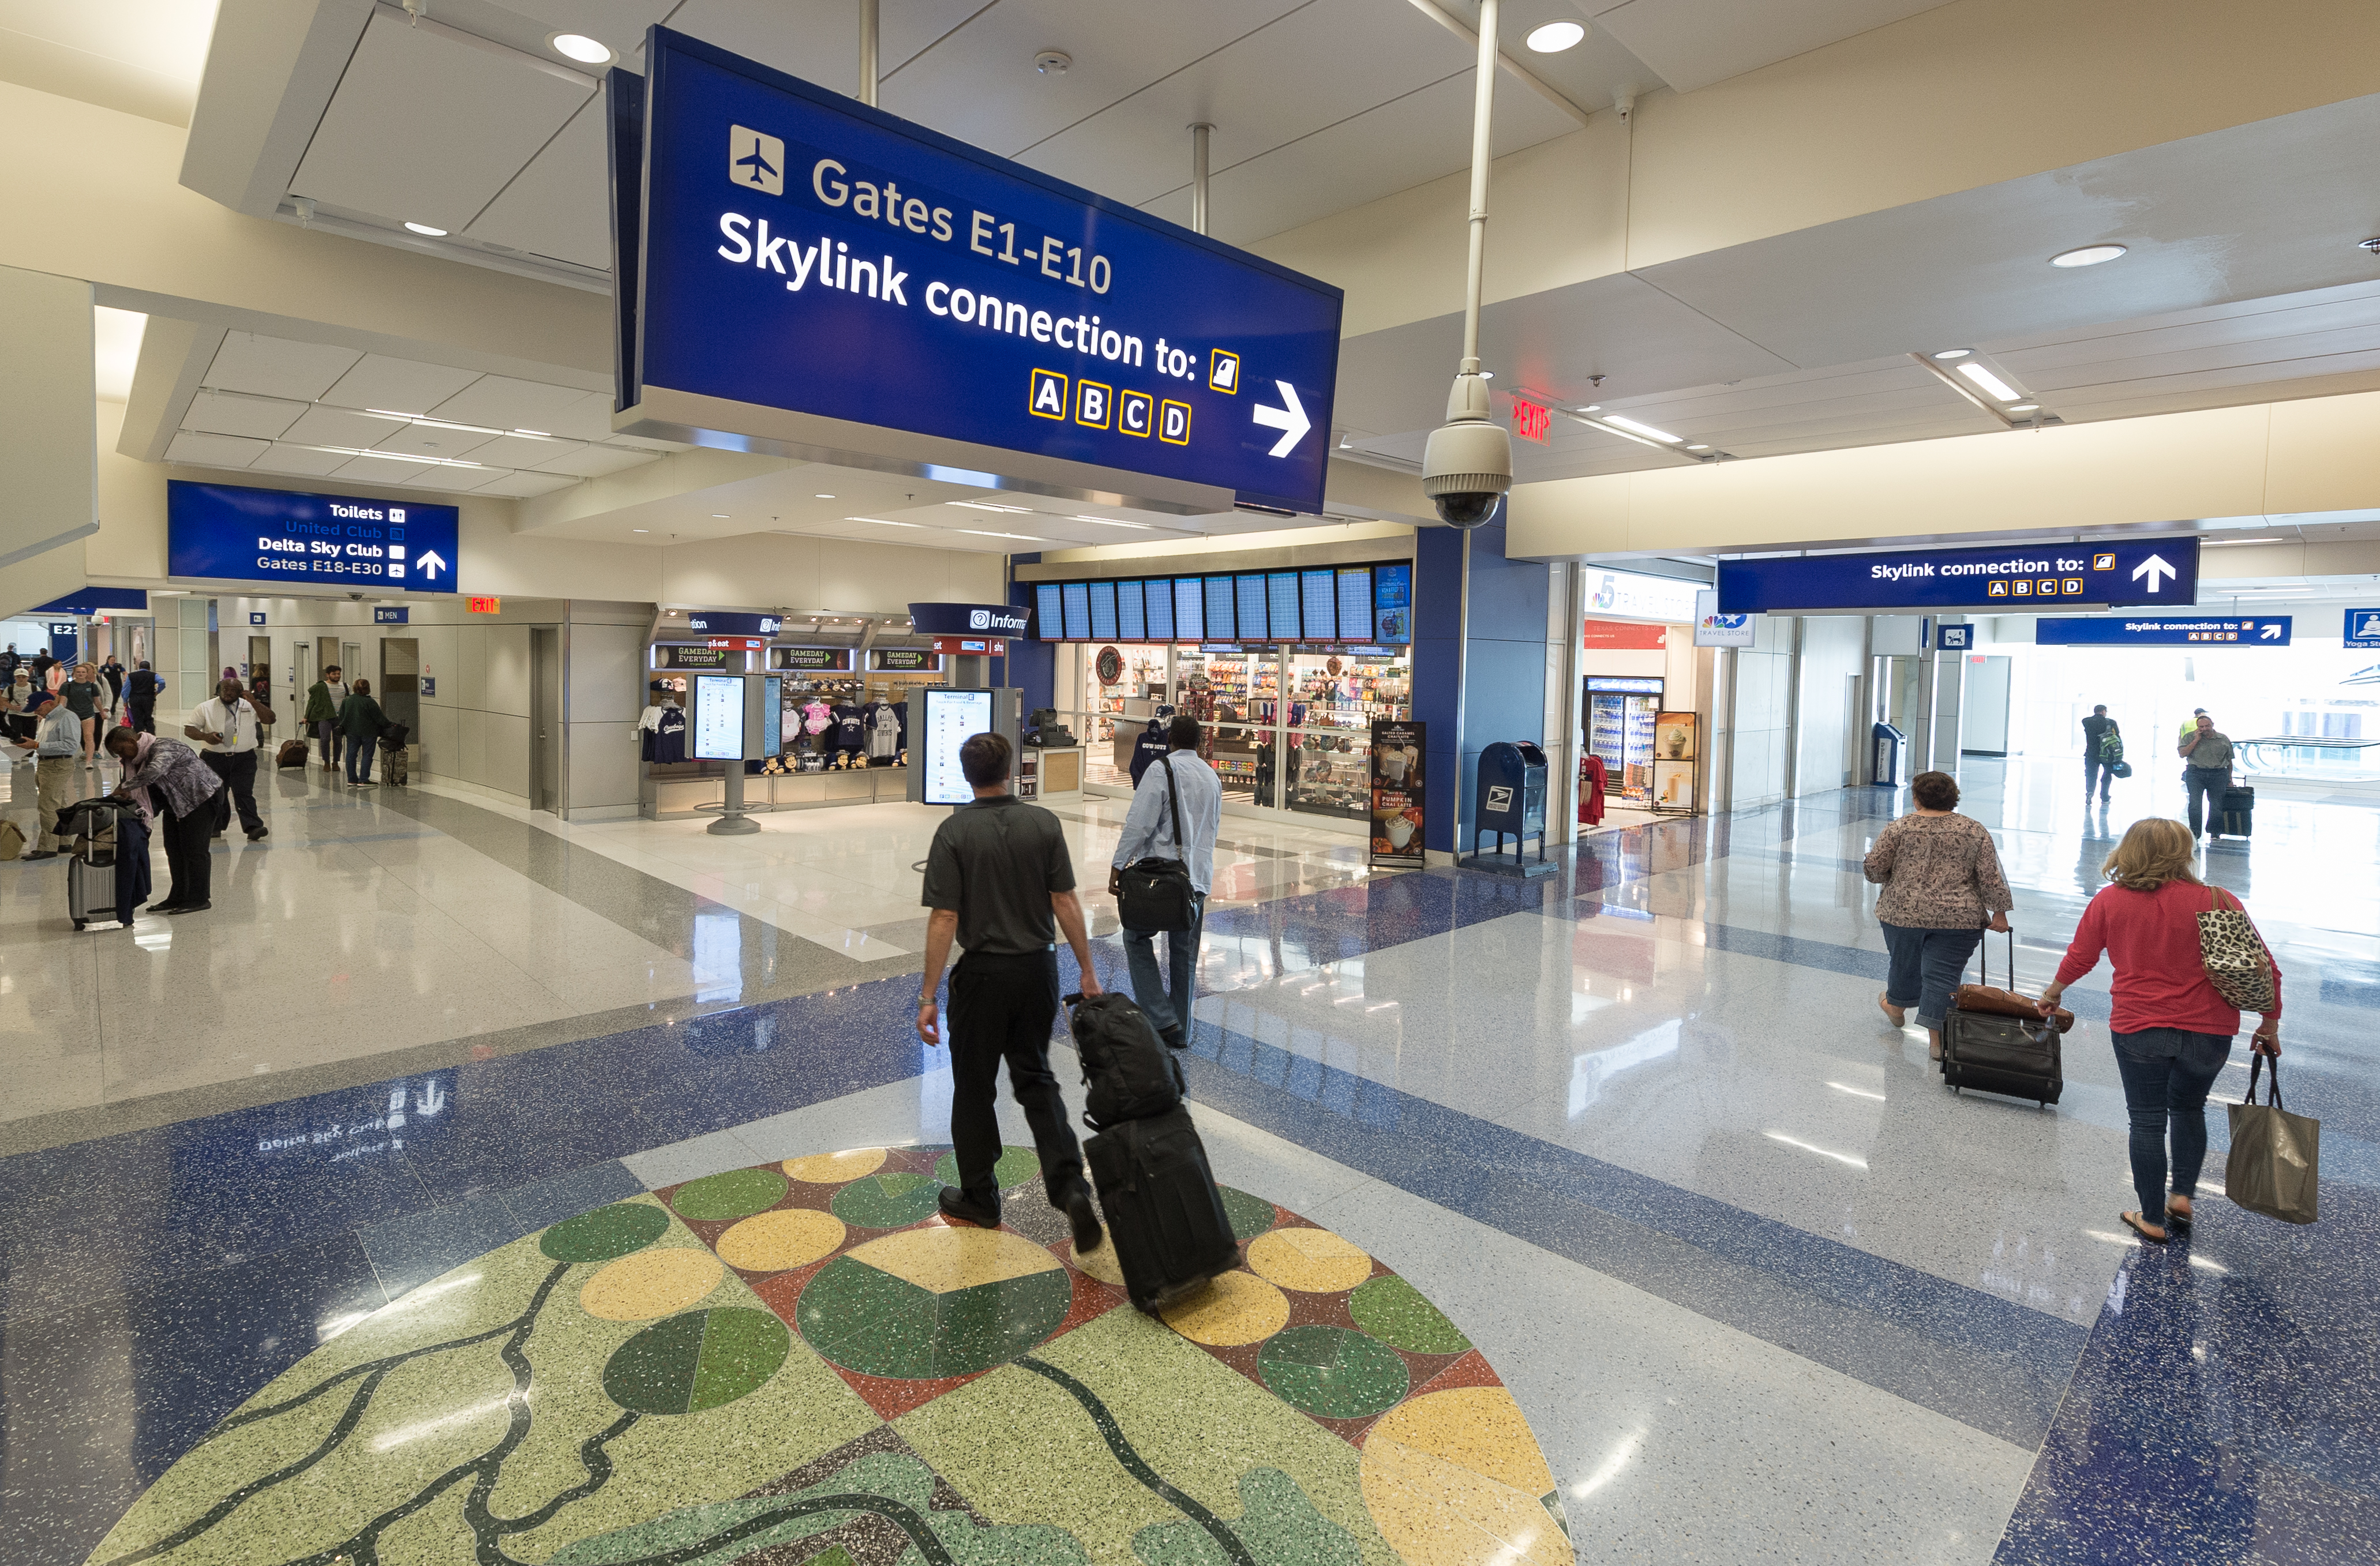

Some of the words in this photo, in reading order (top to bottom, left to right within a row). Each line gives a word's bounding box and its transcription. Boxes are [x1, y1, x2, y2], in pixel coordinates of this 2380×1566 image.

[812, 159, 954, 242] Gates
[970, 210, 1112, 295] E1-E10
[718, 212, 909, 307] Skylink
[925, 280, 1143, 369] connection
[1156, 337, 1197, 381] to:
[1035, 378, 1060, 414] A
[1082, 389, 1103, 422] B
[1126, 399, 1146, 430] C
[1166, 408, 1185, 438] D
[1520, 400, 1546, 441] EXIT
[329, 504, 383, 520] Toilets
[286, 520, 340, 535] United
[347, 525, 382, 539] Club
[258, 538, 305, 553] Delta
[310, 541, 341, 557] Sky
[346, 543, 383, 557] Club
[257, 557, 307, 570] Gates
[313, 559, 382, 575] E18-E30
[1871, 563, 1935, 581] Skylink
[1940, 557, 2049, 576] connection
[2057, 558, 2084, 572] to:
[1991, 583, 2005, 595] A
[2017, 582, 2028, 594] B
[2041, 581, 2053, 594] C
[2066, 581, 2078, 592] D
[472, 598, 495, 613] EXIT
[1617, 592, 1659, 614] TRAVEL
[1665, 598, 1696, 617] STORE
[2125, 623, 2161, 632] Skylink
